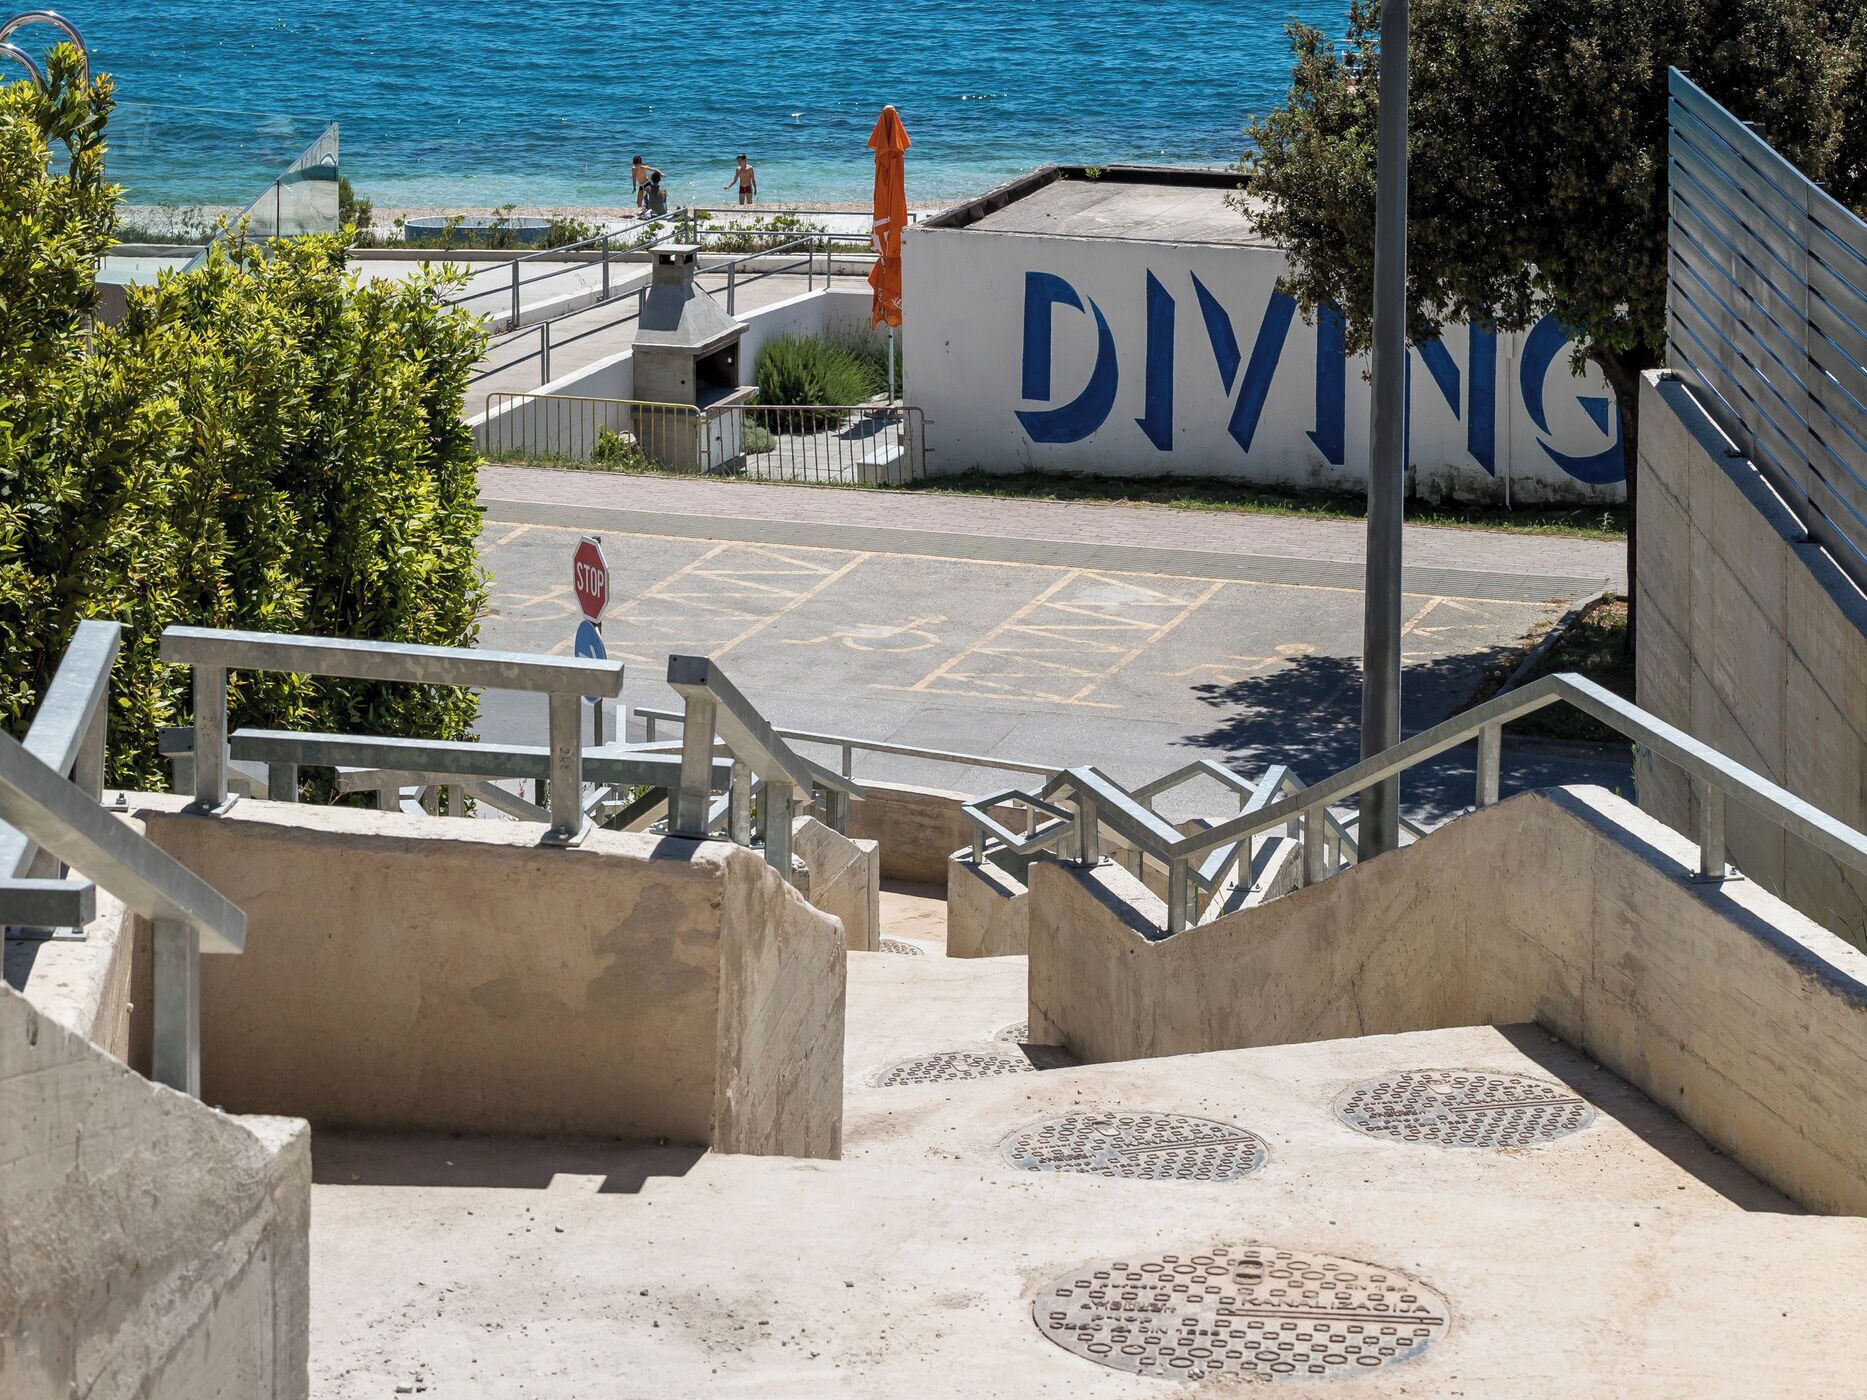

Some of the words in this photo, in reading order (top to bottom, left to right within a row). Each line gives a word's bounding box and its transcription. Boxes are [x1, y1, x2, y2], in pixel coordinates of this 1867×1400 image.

[1014, 268, 1627, 484] DIVING
[576, 561, 605, 598] STOP
[1454, 1093, 1570, 1106] KANALIZACIJA
[1122, 1131, 1239, 1149] KANALIZACIJA
[1241, 1297, 1431, 1315] KANALIZACIJA
